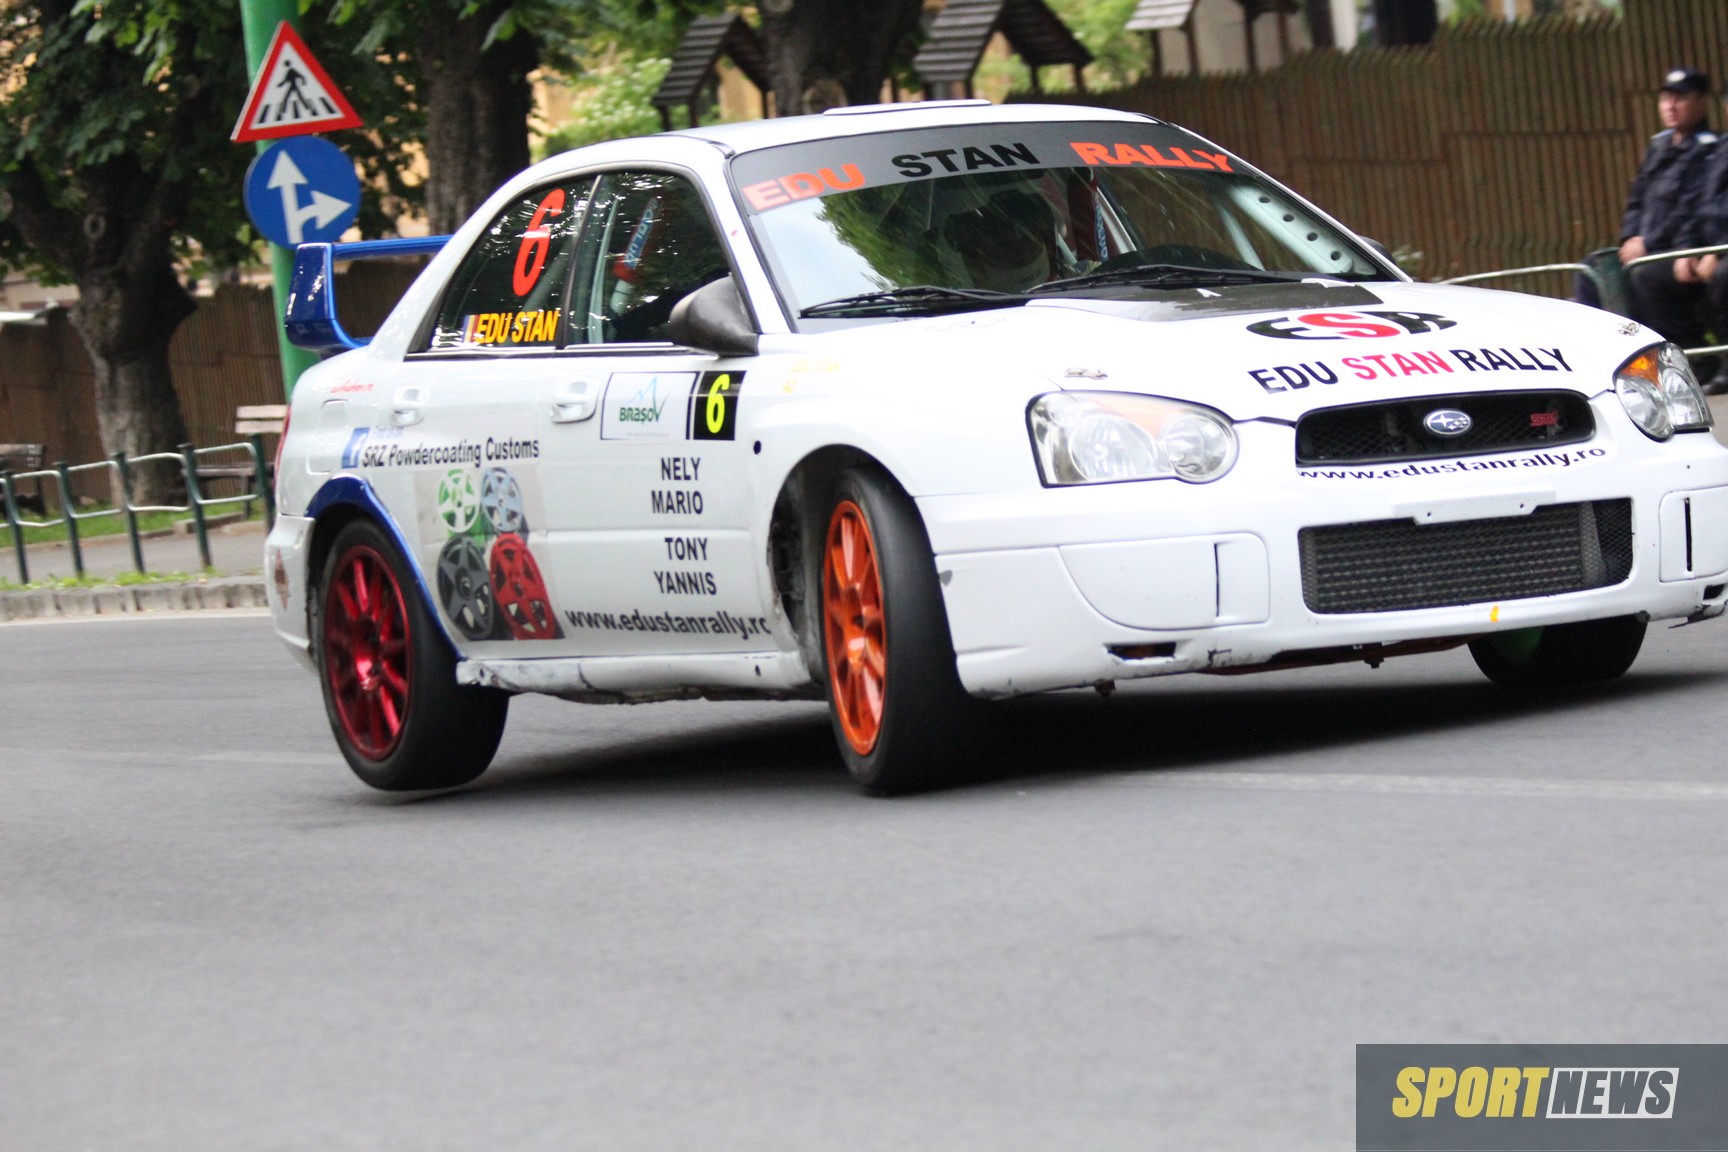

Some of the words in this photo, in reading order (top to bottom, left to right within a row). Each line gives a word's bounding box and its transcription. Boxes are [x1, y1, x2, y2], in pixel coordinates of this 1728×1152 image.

[742, 163, 867, 211] EDU
[891, 142, 1041, 178] STAN
[1069, 141, 1233, 173] RALLY
[513, 188, 565, 296] 6
[474, 312, 513, 344] EDU
[511, 310, 561, 343] STAN
[1248, 361, 1339, 394] EDU
[1341, 351, 1455, 380] STAN
[1448, 348, 1573, 372] RALLY
[706, 373, 730, 434] 6
[388, 439, 482, 468] Powdercoating
[485, 436, 539, 461] Customs
[661, 457, 701, 480] NELY
[651, 490, 703, 515] MARIO
[664, 537, 708, 561] TONY
[654, 571, 717, 596] YANNIS
